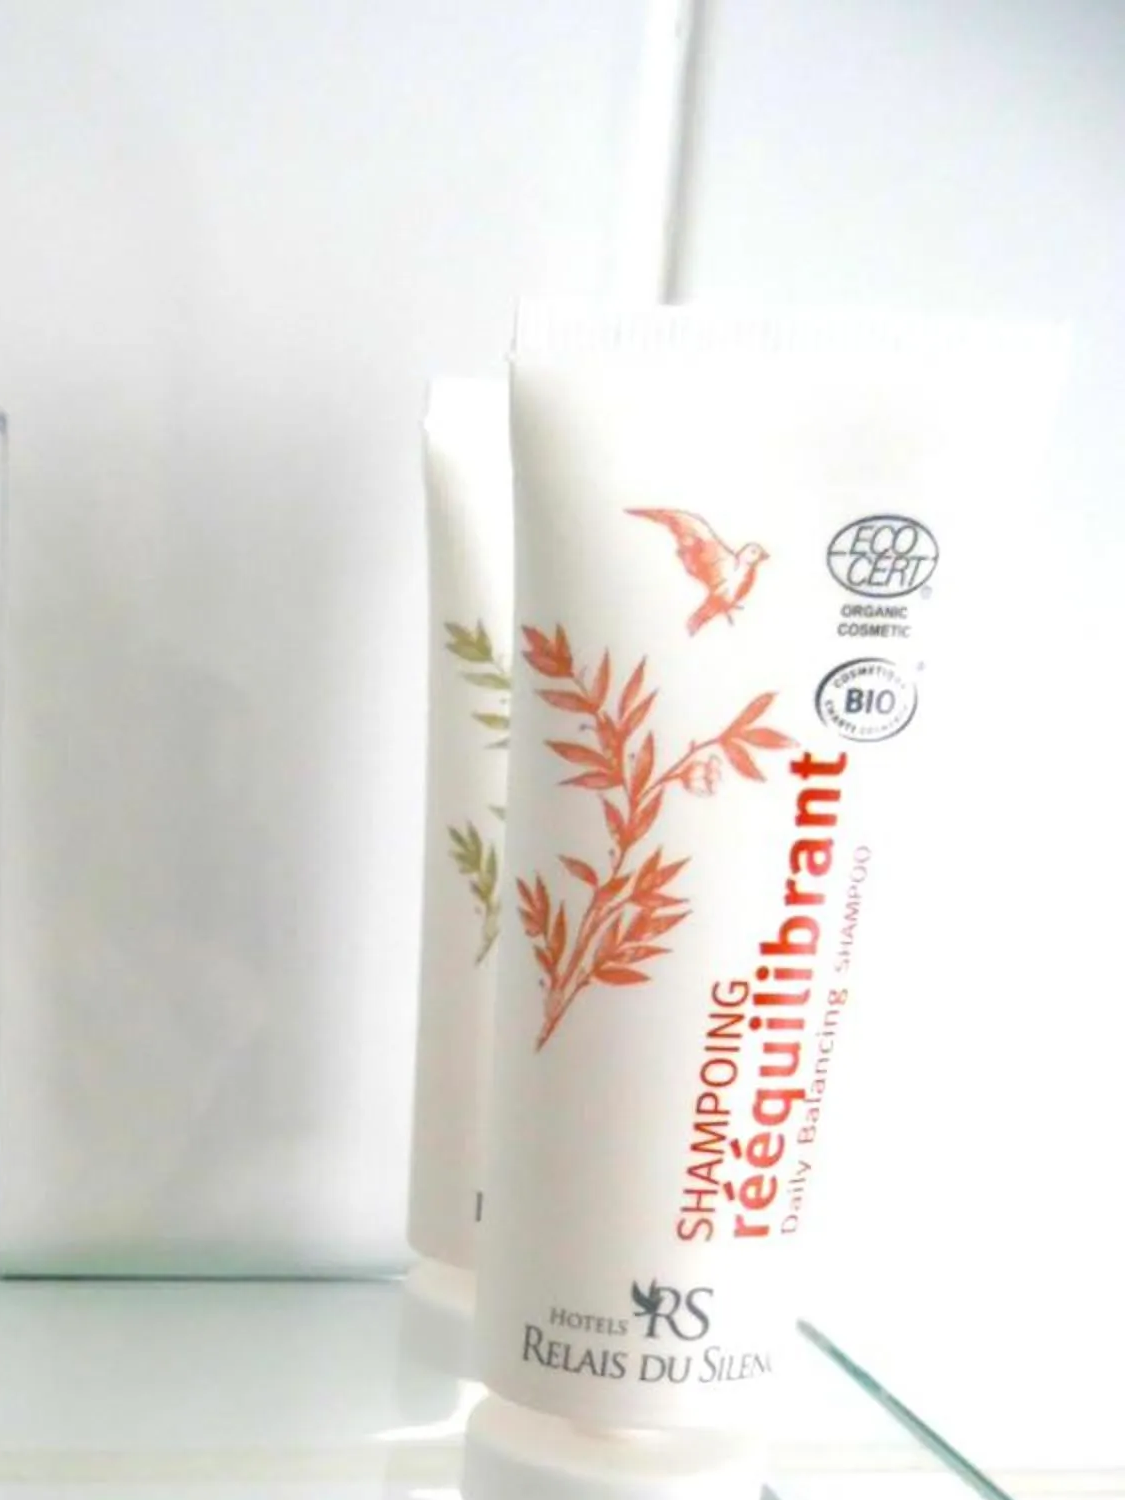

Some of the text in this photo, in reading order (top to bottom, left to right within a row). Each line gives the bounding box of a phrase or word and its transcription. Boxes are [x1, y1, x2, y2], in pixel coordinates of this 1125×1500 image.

[837, 622, 912, 638] COSMETIC
[840, 603, 908, 619] ORGANIC
[845, 688, 896, 714] BIO
[723, 751, 848, 1239] rééquilibrant
[780, 844, 872, 1235] Daily Balancing SHAMPOO
[676, 980, 750, 1242] SHAMPOING
[549, 1285, 714, 1341] HOTELS RS
[522, 1323, 628, 1379] RELAIS
[638, 1352, 692, 1384] DU
